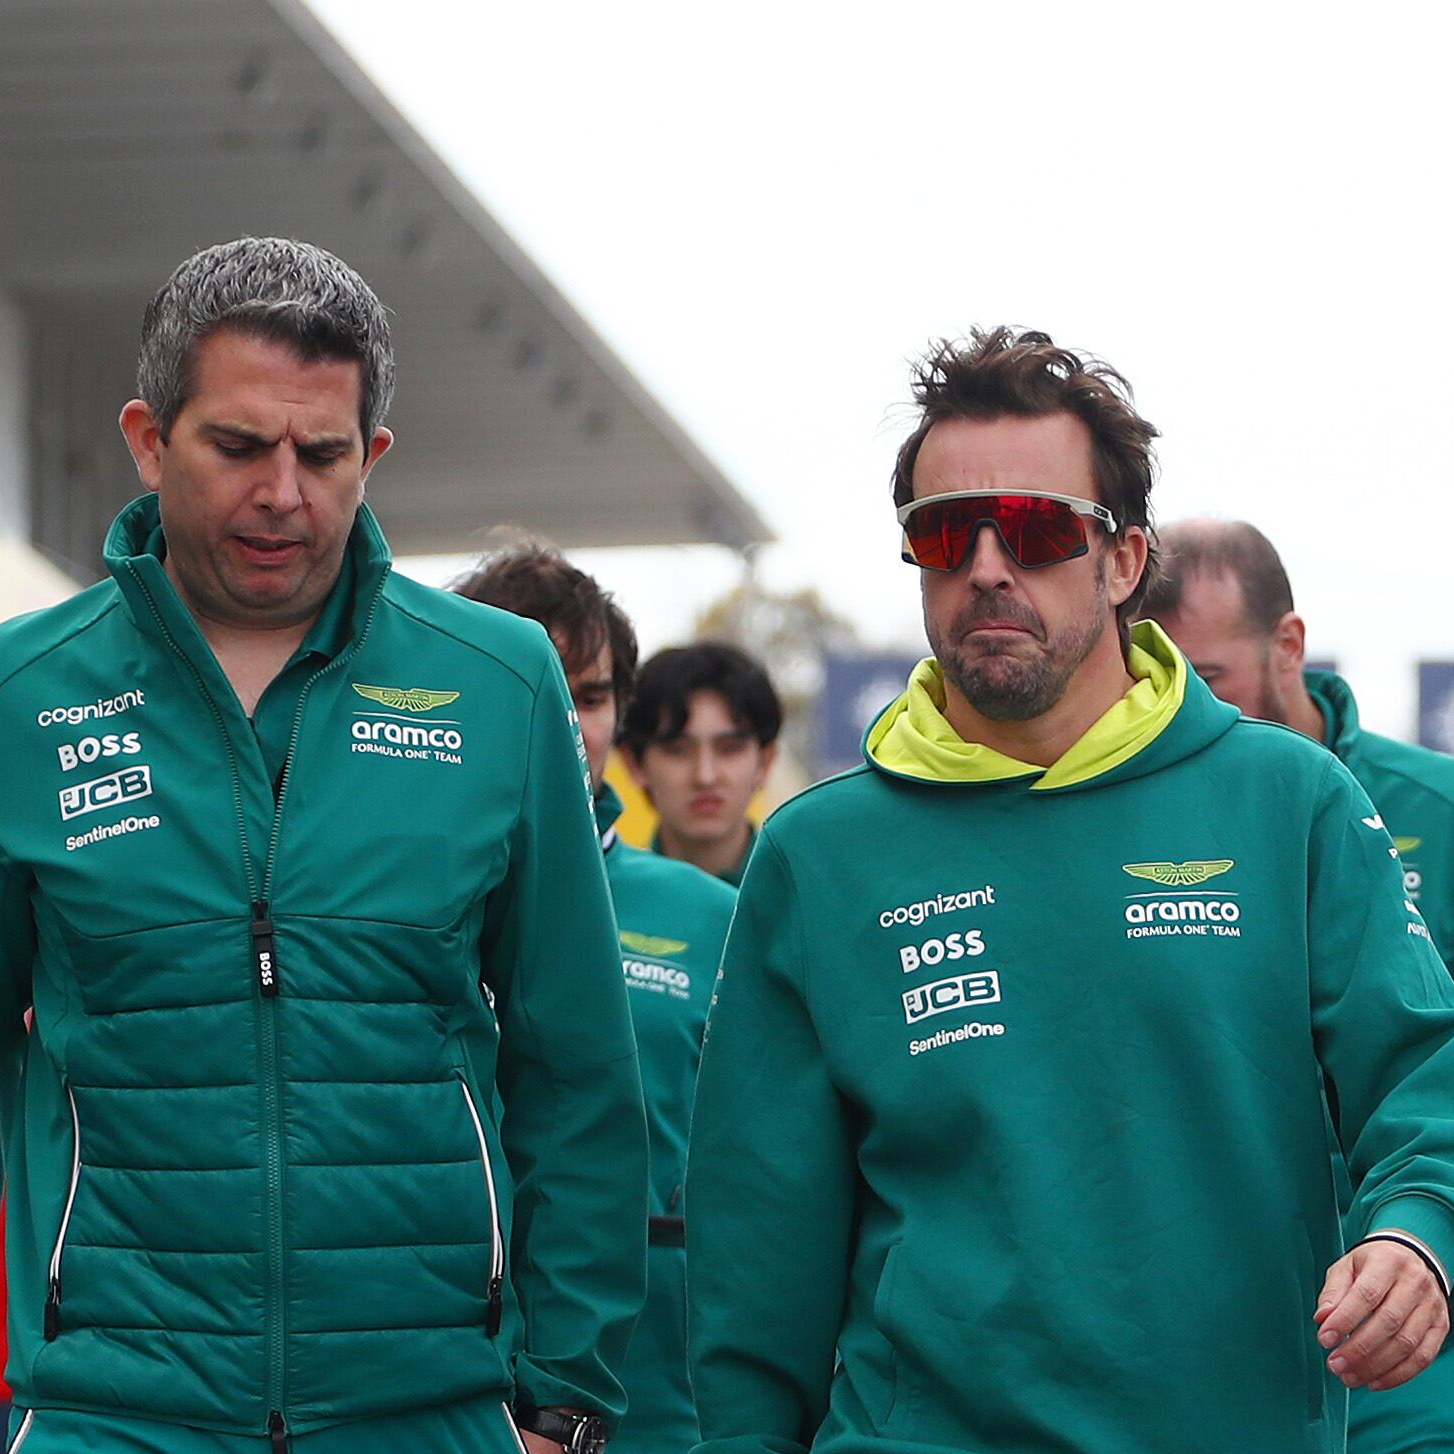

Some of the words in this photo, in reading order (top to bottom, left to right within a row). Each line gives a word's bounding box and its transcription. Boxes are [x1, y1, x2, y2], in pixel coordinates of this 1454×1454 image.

[37, 689, 145, 727] cognizant
[57, 732, 142, 772] BOSS
[351, 721, 462, 750] aramco
[351, 743, 403, 758] FORMULA
[404, 749, 430, 760] ONE
[433, 751, 462, 765] TEAM
[61, 768, 149, 816] JCB
[66, 815, 160, 851] SentinelOne
[879, 885, 995, 928] cognizant
[1125, 901, 1240, 923] aramco
[1127, 925, 1181, 939] FORMULA
[1183, 925, 1207, 935] ONE
[1211, 925, 1241, 937] TEAM
[899, 929, 986, 973] BOSS
[259, 952, 273, 986] BOSS
[622, 959, 690, 989] ramco
[905, 974, 997, 1020] JCB
[909, 1022, 1005, 1056] SentinelOne
